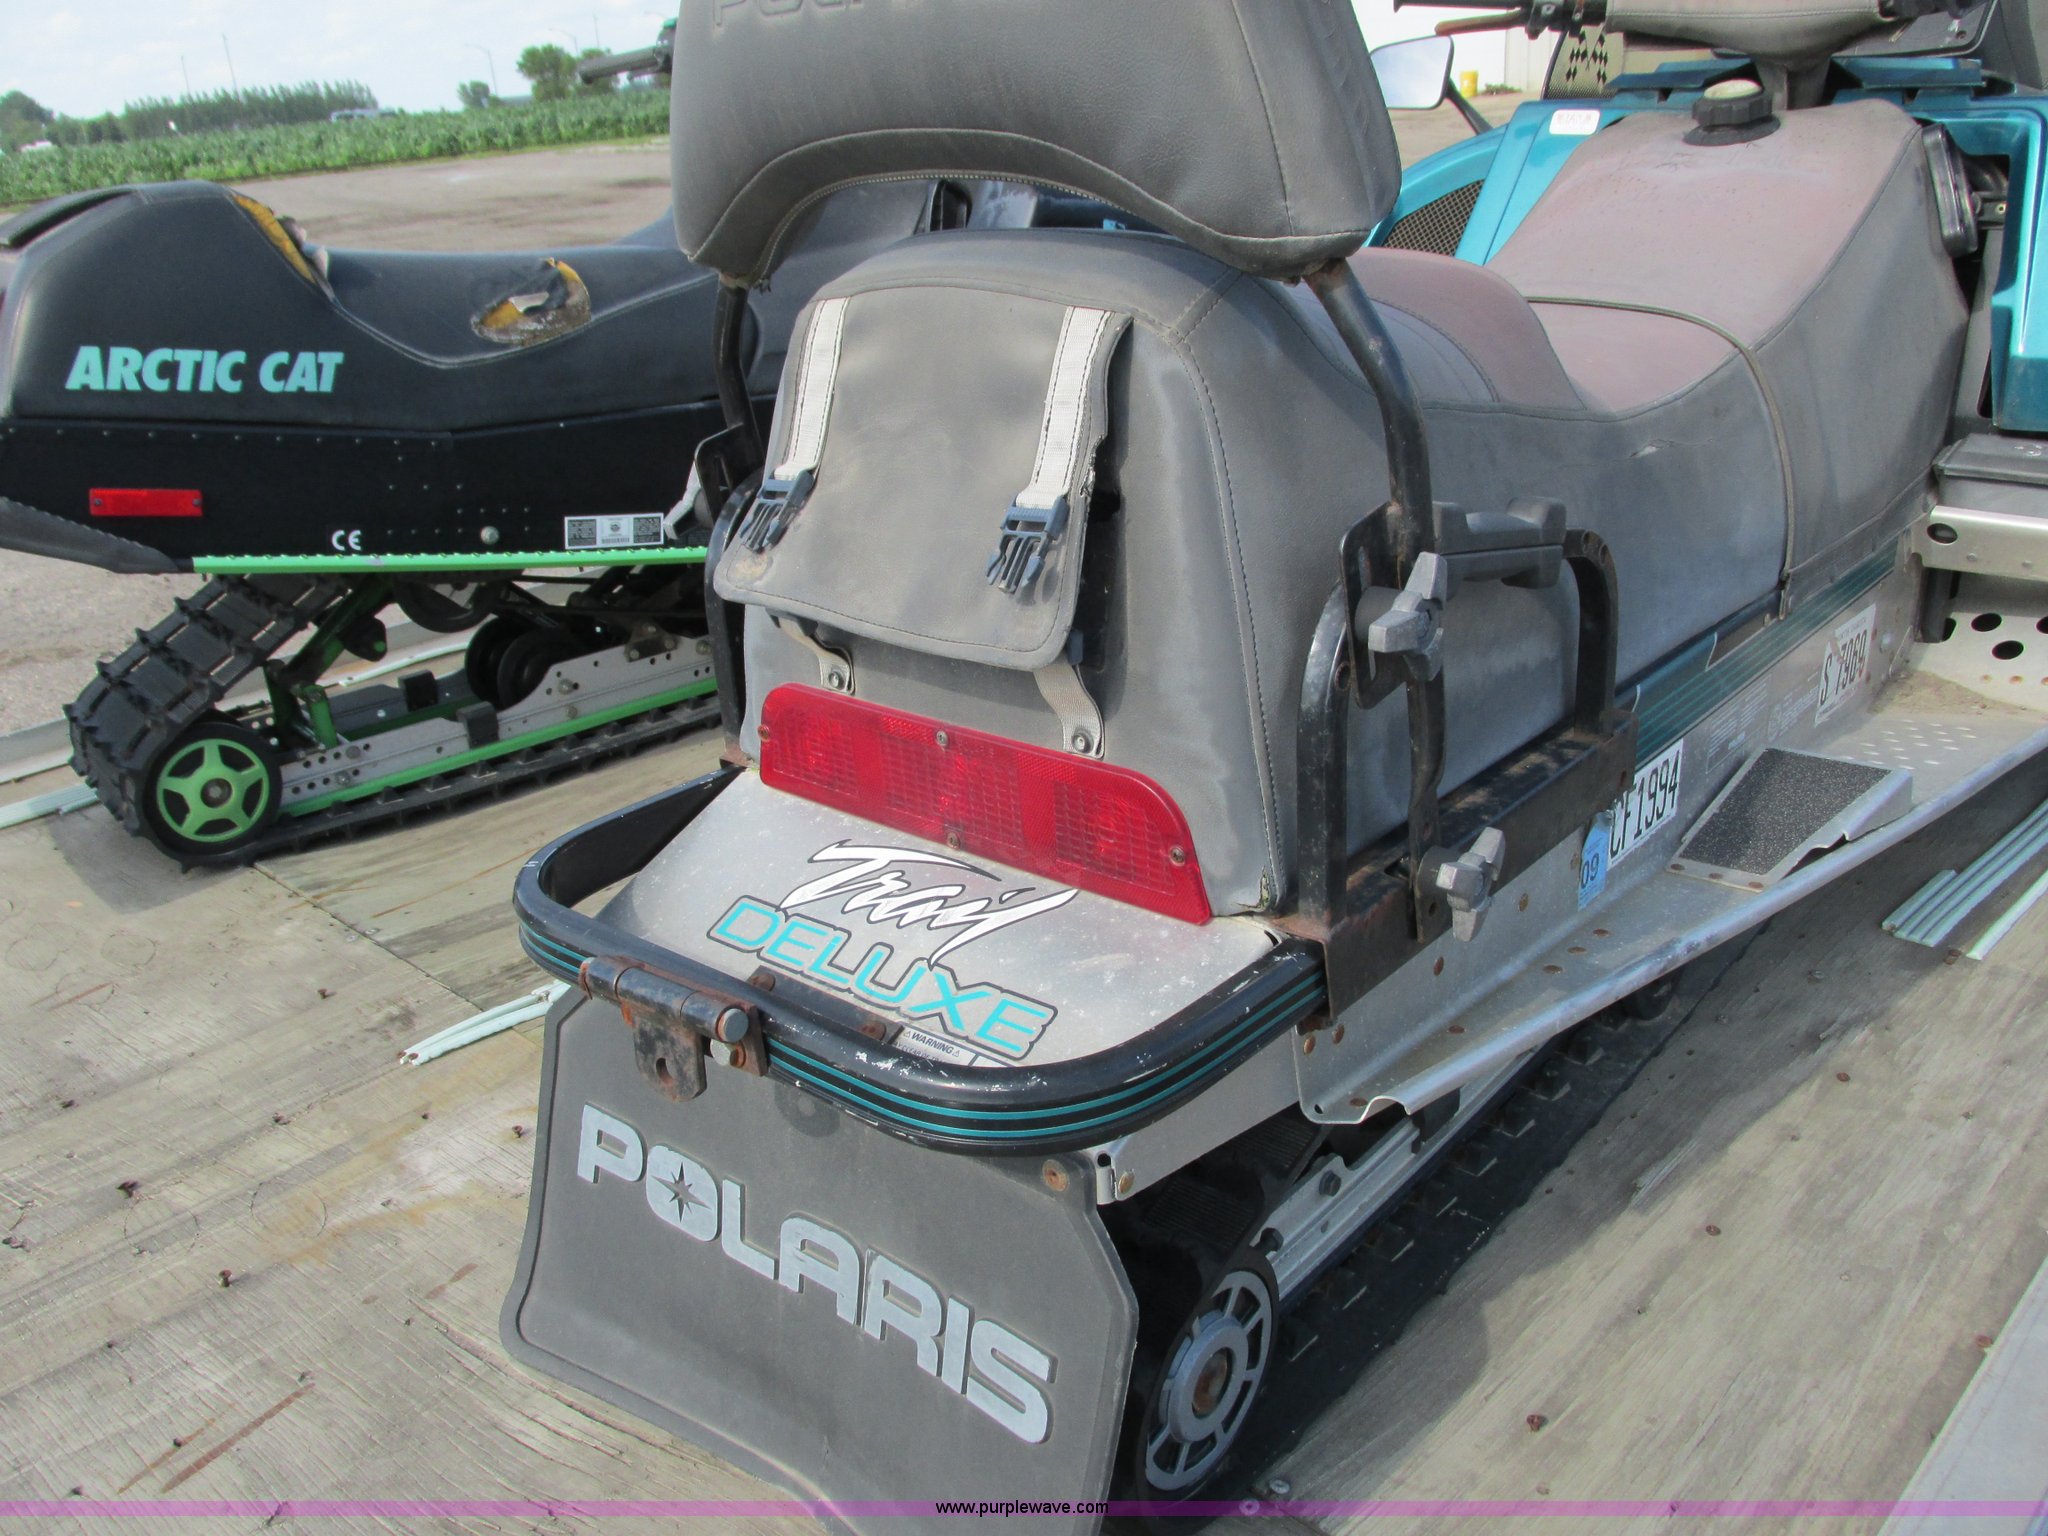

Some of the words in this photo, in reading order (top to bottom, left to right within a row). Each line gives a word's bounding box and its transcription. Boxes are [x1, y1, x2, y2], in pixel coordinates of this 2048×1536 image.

[65, 345, 247, 393] ARCTIC
[259, 351, 345, 392] CAT
[332, 530, 361, 551] CE
[1580, 853, 1599, 889] 09
[780, 839, 1079, 969] Trail
[711, 899, 1052, 1056] DELUXE
[911, 1032, 954, 1054] WARNING
[577, 1104, 1055, 1442] POLARIS
